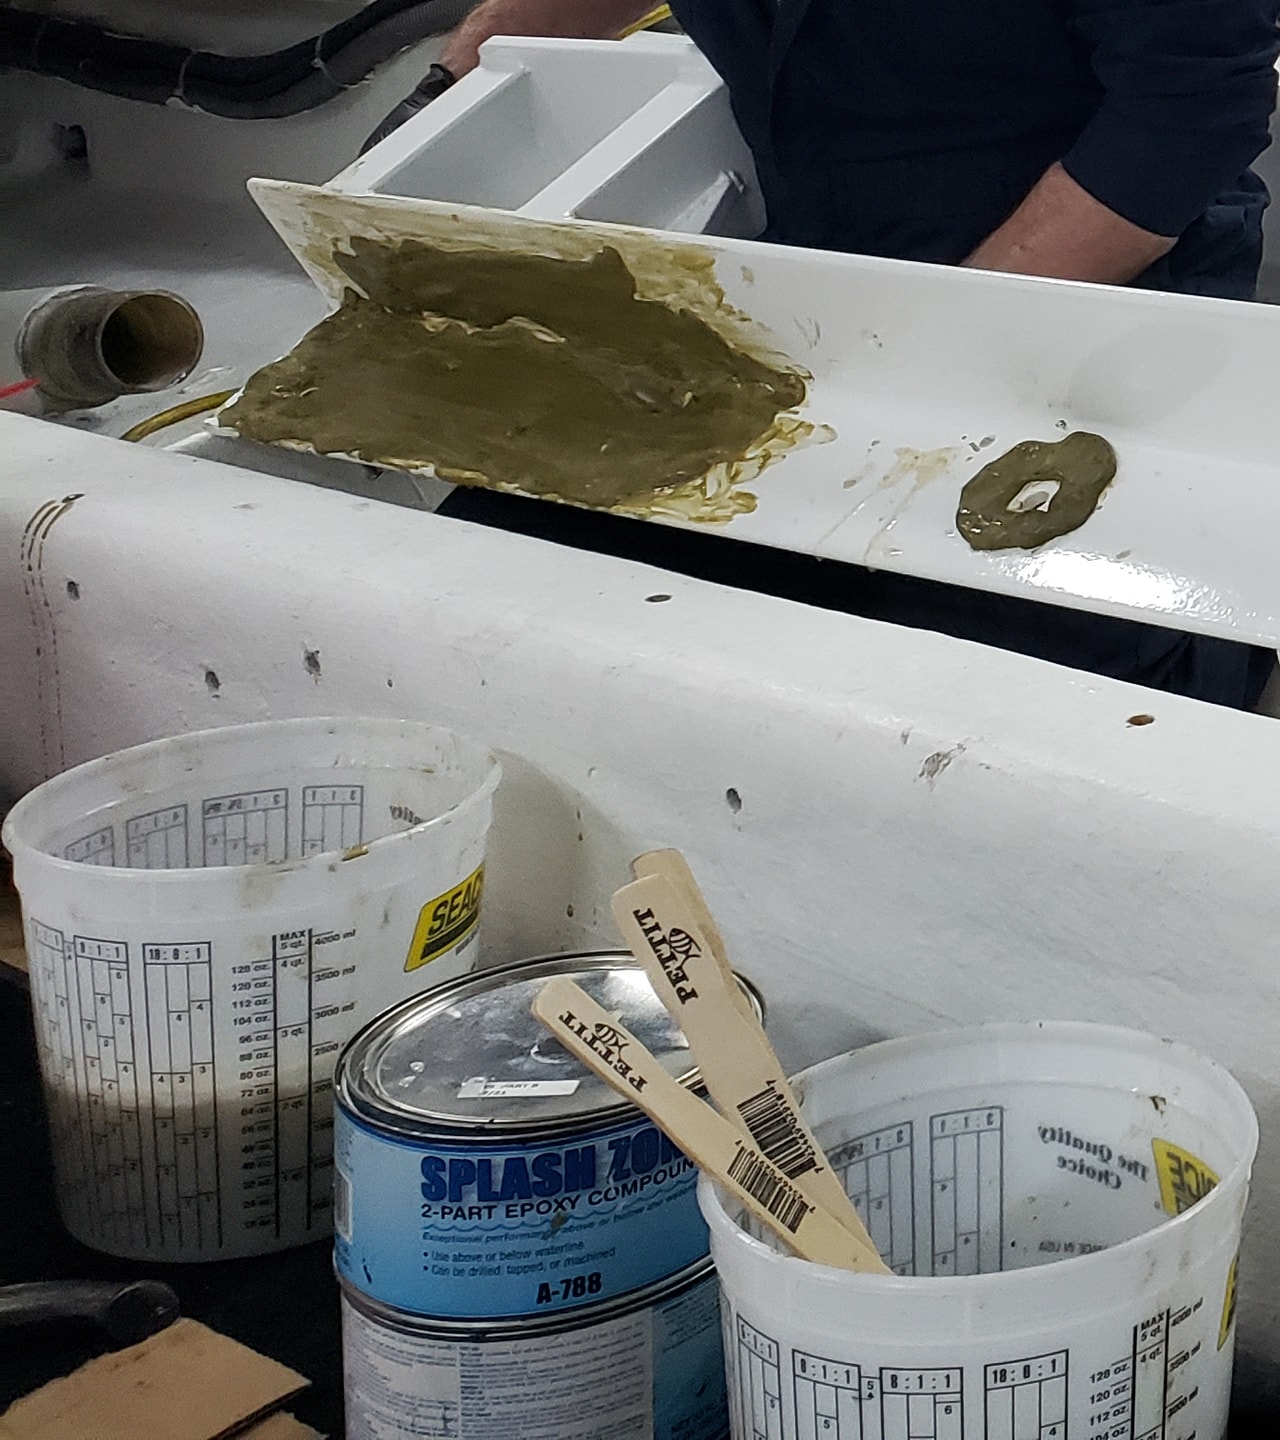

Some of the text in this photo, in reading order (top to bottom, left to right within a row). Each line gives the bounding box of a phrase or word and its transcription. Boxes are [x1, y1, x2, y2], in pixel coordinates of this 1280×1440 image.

[280, 929, 306, 941] MAX
[632, 908, 698, 1005] PETTIT
[558, 1010, 648, 1093] PETTIT
[420, 1144, 597, 1203] SPLASH
[421, 1203, 498, 1222] 2-PART
[504, 1194, 581, 1220] EPOXY
[431, 1264, 449, 1276] Can
[451, 1264, 466, 1277] be
[563, 1247, 616, 1267] machined
[451, 1250, 482, 1262] above
[500, 1247, 532, 1261] below
[534, 1240, 585, 1258] waterline
[536, 1272, 602, 1305] A-788
[1140, 1311, 1165, 1332] MAX
[1089, 1367, 1111, 1384] 128
[1088, 1388, 1111, 1405] 120
[1088, 1410, 1110, 1427] 112
[1048, 1426, 1057, 1437] 4
